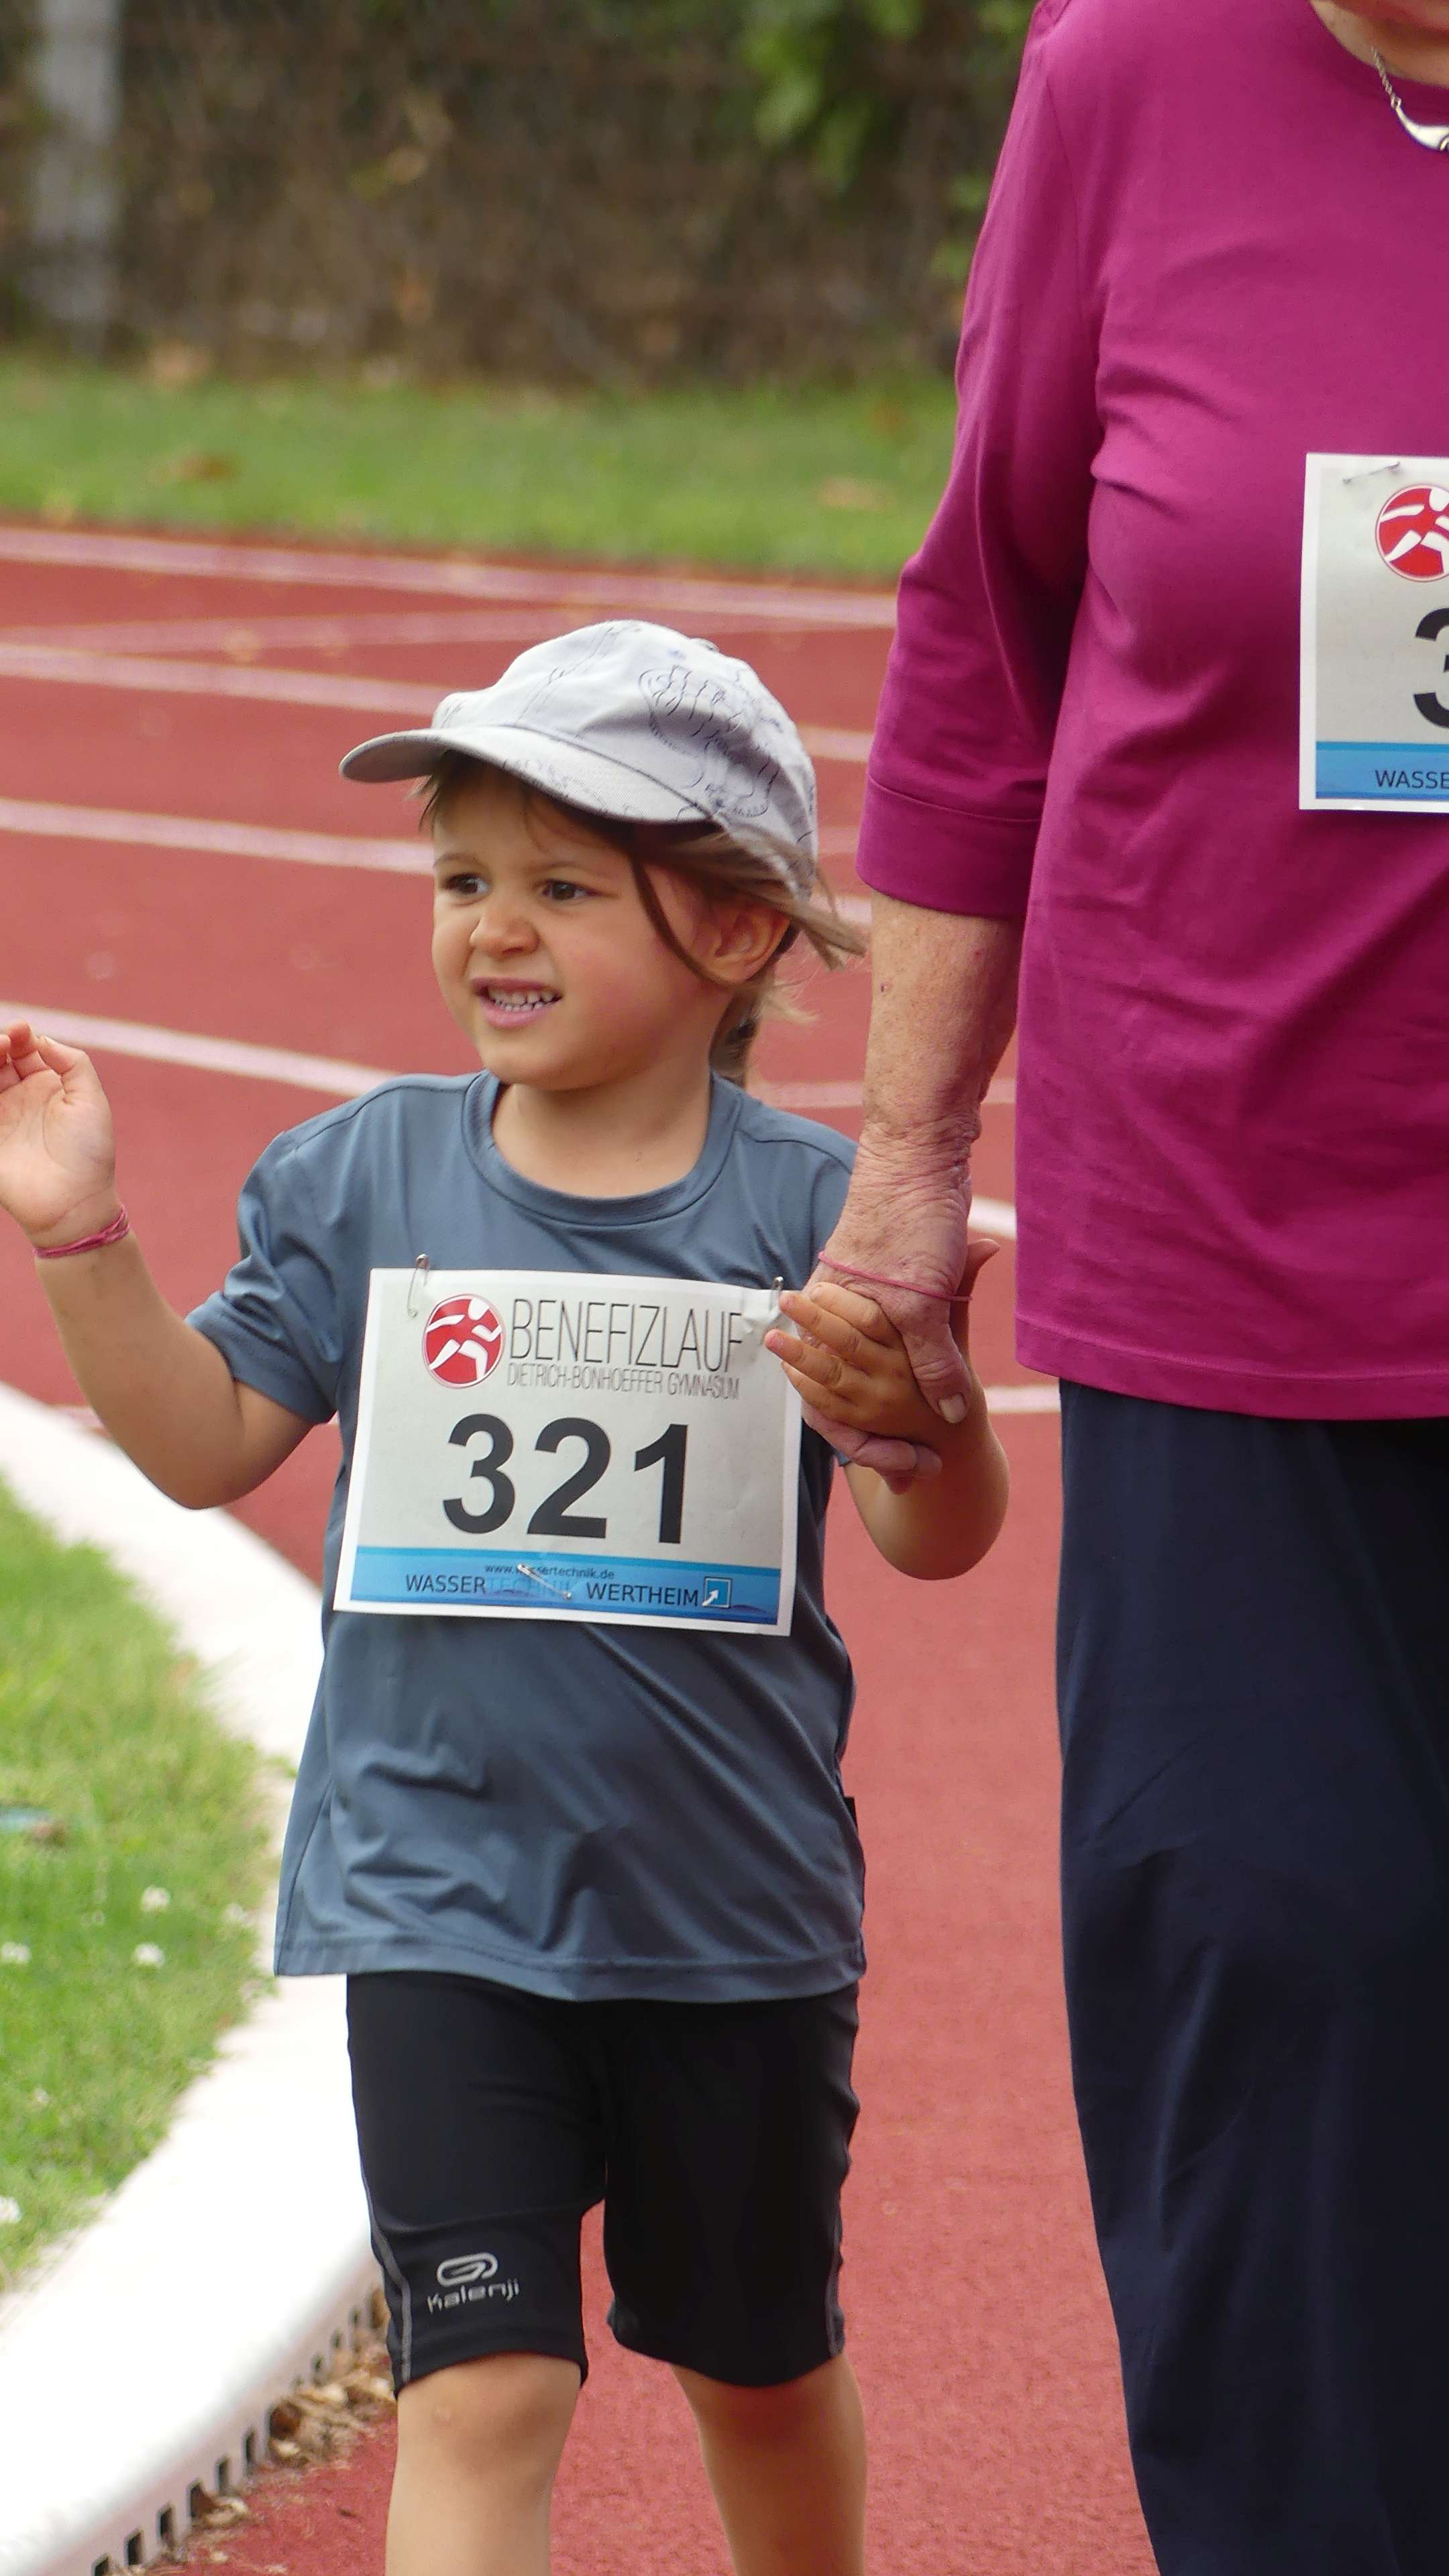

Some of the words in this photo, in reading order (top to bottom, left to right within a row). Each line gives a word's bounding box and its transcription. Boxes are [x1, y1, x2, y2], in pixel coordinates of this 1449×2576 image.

[509, 1298, 743, 1373] BENEFIZLAUF
[506, 1362, 663, 1394] DIETRICH-BONHOEFFER
[442, 1413, 690, 1545] 321
[586, 1580, 699, 1607] WERTHEIM
